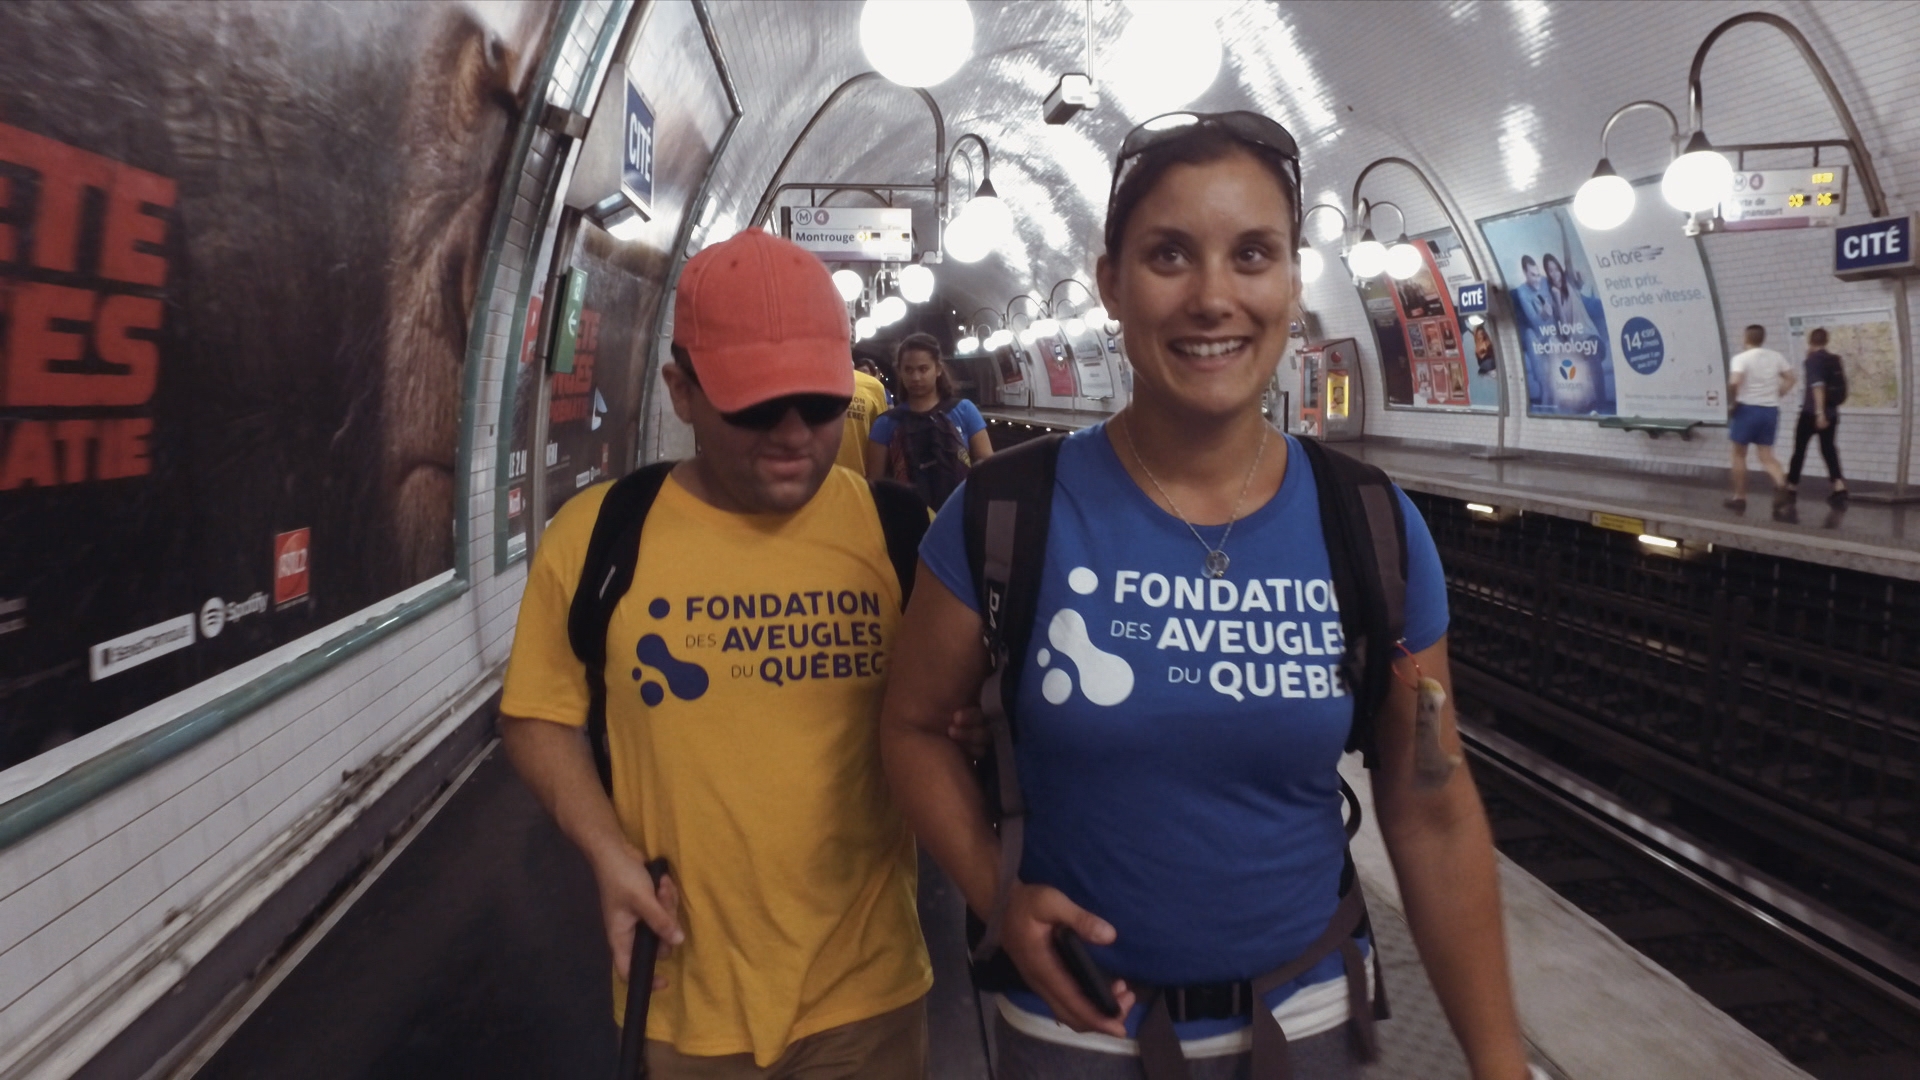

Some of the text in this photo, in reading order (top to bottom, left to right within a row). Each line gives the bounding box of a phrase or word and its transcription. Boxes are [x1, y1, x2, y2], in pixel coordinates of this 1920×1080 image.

[629, 112, 651, 182] CITÉ
[0, 122, 178, 288] TE
[795, 232, 854, 243] Montrouge
[1843, 226, 1901, 259] CITÉ
[1611, 249, 1643, 267] fibre
[1604, 275, 1662, 291] Petit prix.
[1461, 288, 1483, 307] CITÉ
[1610, 288, 1706, 308] Grande vitesse.
[1539, 321, 1584, 336] we love
[0, 282, 163, 407] ES
[1533, 339, 1598, 355] technology
[1624, 331, 1642, 351] 14
[686, 591, 880, 621] FONDATION
[686, 622, 883, 652] DES AVEUGLES
[1110, 620, 1151, 641] DES
[732, 652, 884, 687] DU QUÉBEC
[1168, 660, 1346, 702] DU QUÉBE
